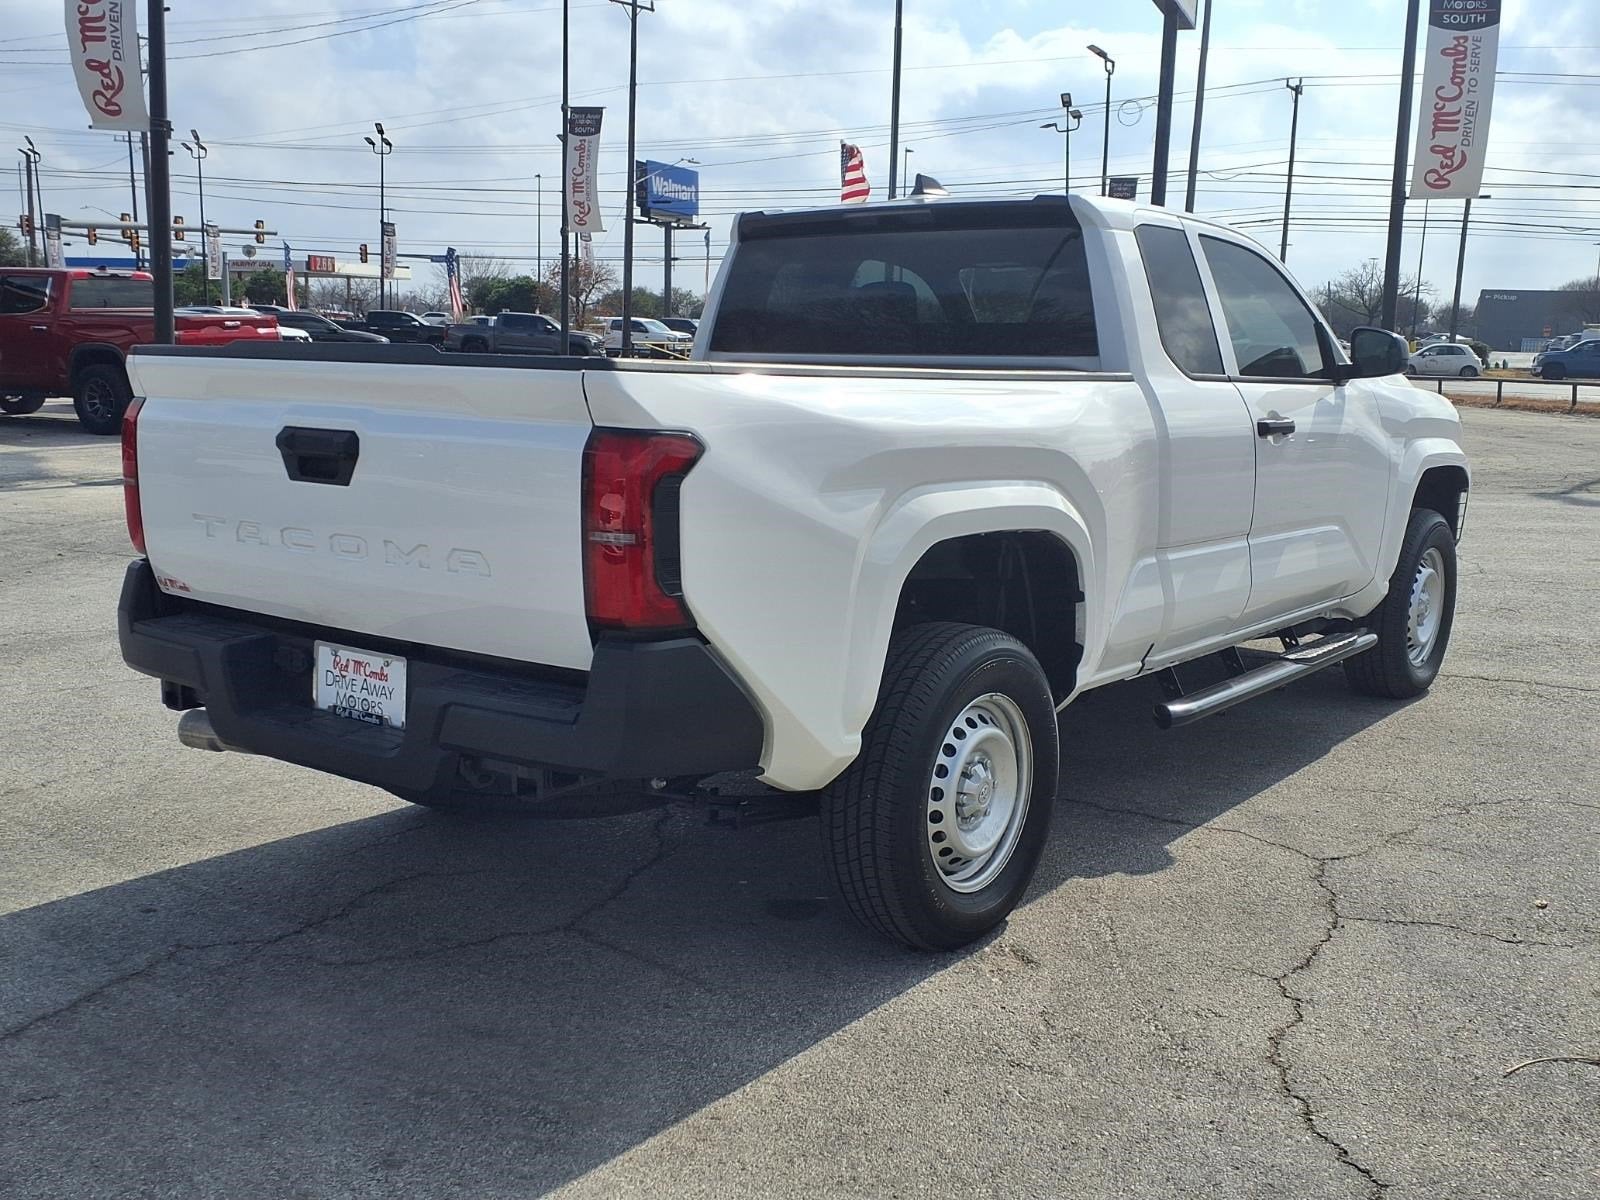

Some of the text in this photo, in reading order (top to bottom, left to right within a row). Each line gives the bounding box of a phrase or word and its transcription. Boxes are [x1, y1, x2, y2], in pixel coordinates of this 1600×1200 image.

[1443, 0, 1487, 9] MOTORS
[1443, 13, 1486, 24] SOUTH
[109, 2, 123, 61] DRIVEN
[85, 59, 124, 116] Red
[1461, 35, 1482, 147] DRIVEN TO SERVE
[1424, 35, 1469, 189] Red McCombs
[572, 138, 586, 198] McCombs
[652, 175, 697, 203] Walmart
[574, 200, 591, 226] Red
[192, 512, 491, 577] TACOMA
[333, 655, 388, 682] Red McCombs
[326, 670, 395, 700] DRIVE AWAY
[336, 691, 384, 715] MOTORS
